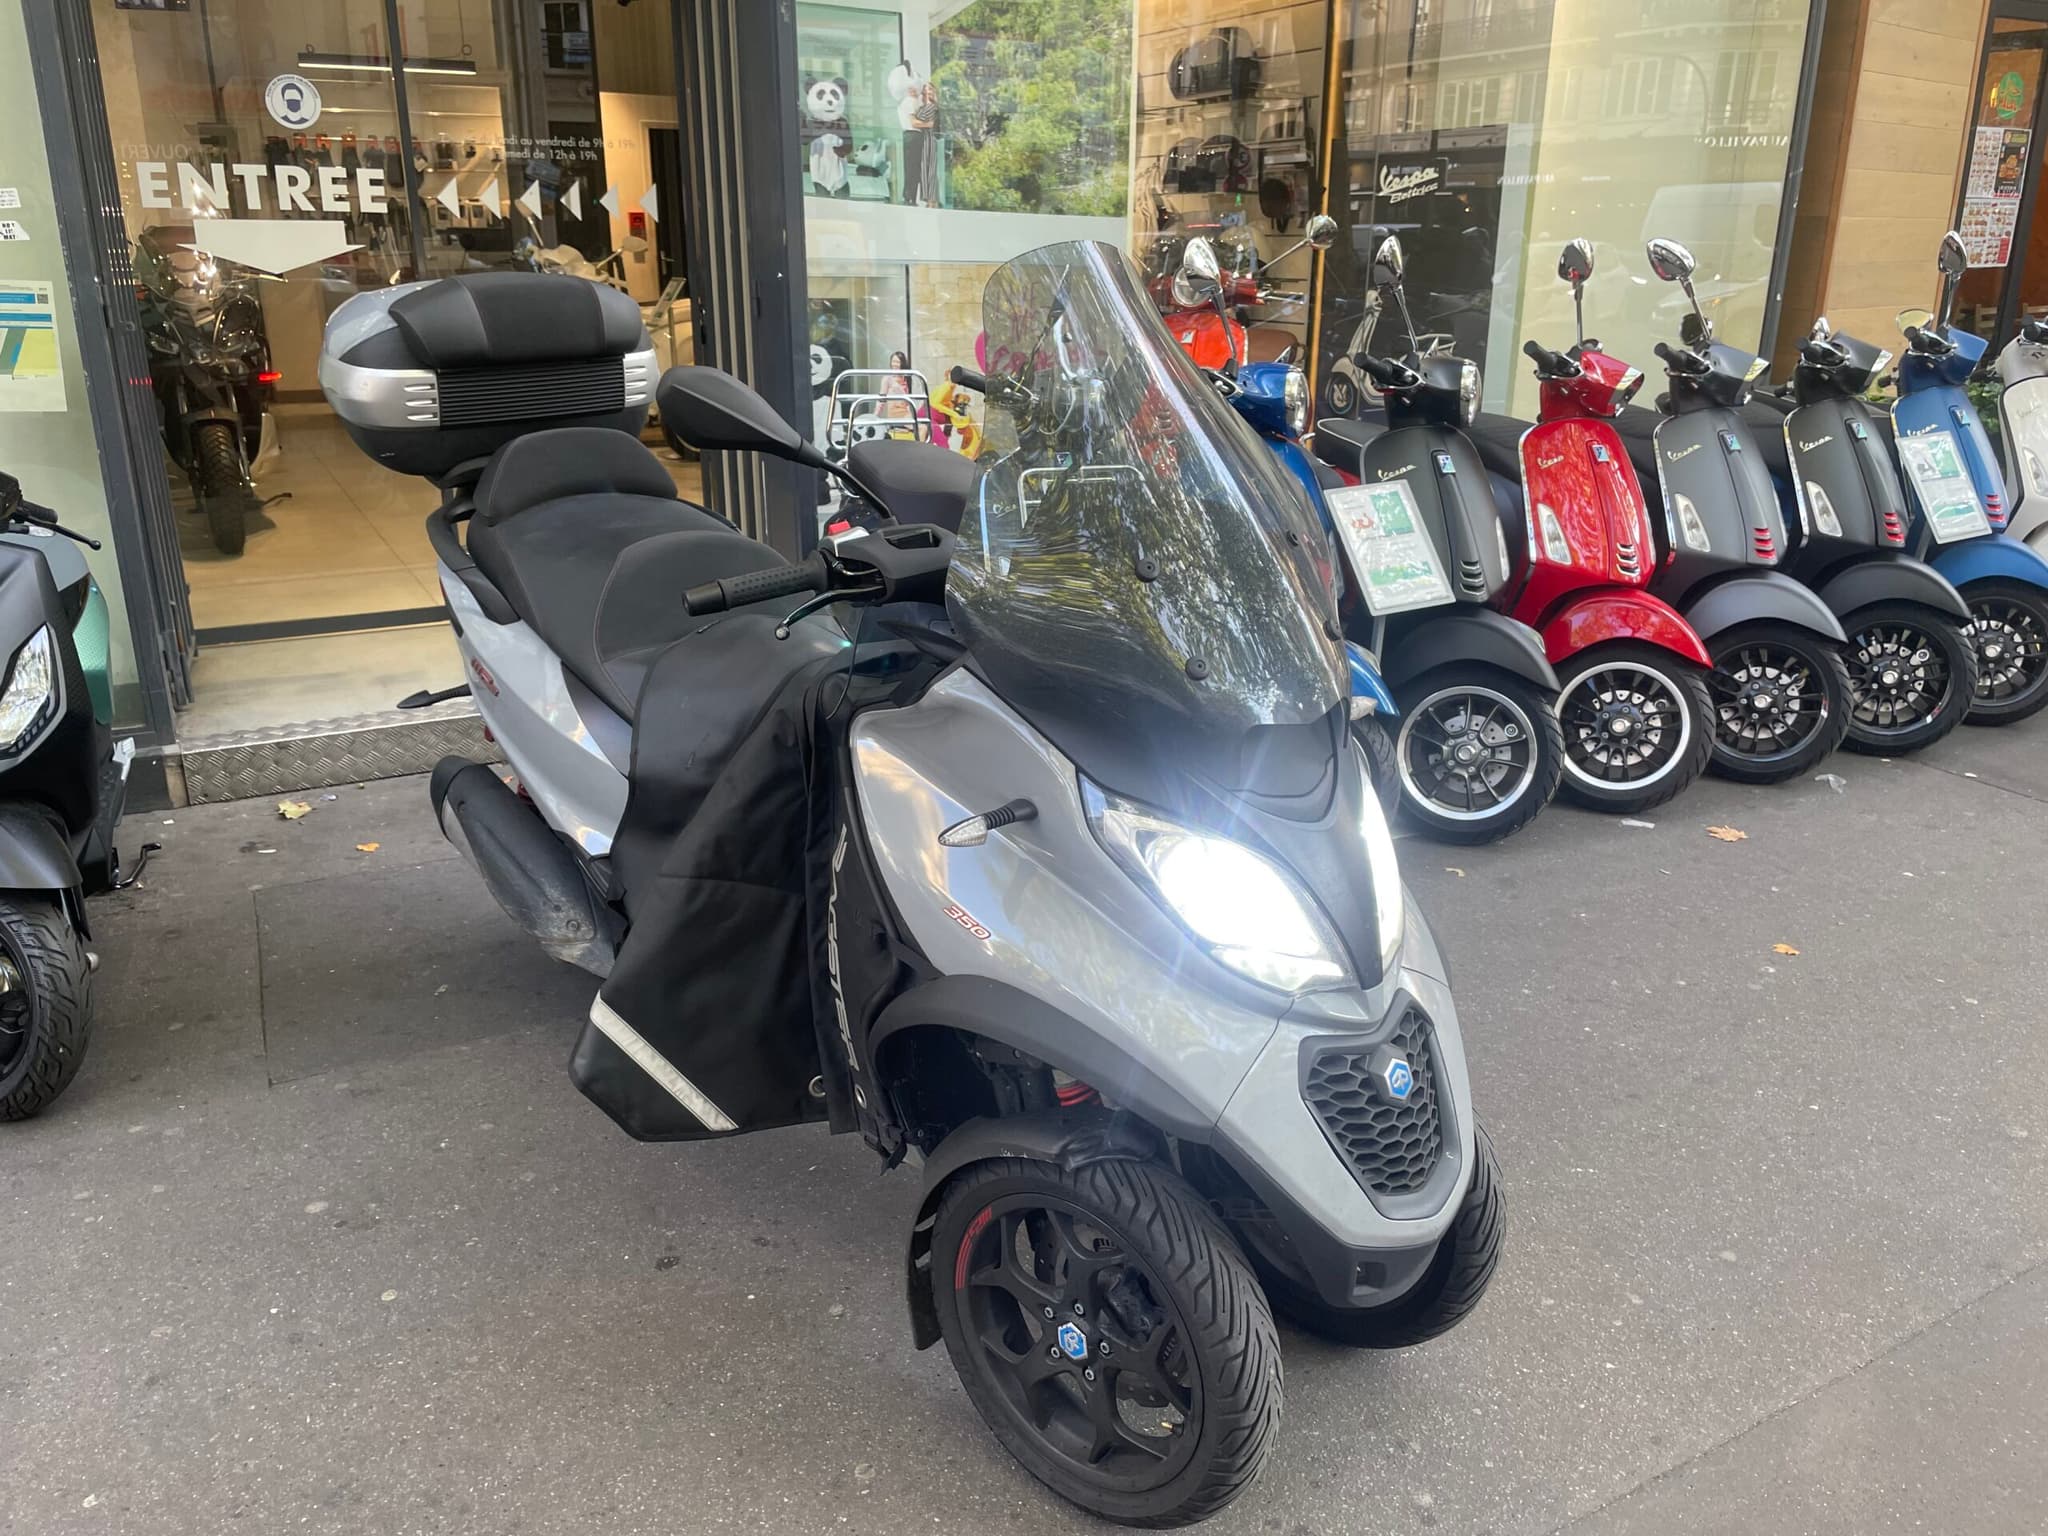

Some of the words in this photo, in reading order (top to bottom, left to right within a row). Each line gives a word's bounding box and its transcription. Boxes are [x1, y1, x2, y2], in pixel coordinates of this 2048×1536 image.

[521, 138, 532, 146] au
[535, 135, 576, 148] vendredi
[578, 137, 591, 148] de
[533, 148, 546, 160] de
[549, 148, 567, 161] 12h
[580, 149, 597, 161] 19h
[135, 161, 389, 214] ENTREE
[1376, 165, 1439, 196] Vespa
[943, 905, 992, 940] 350
